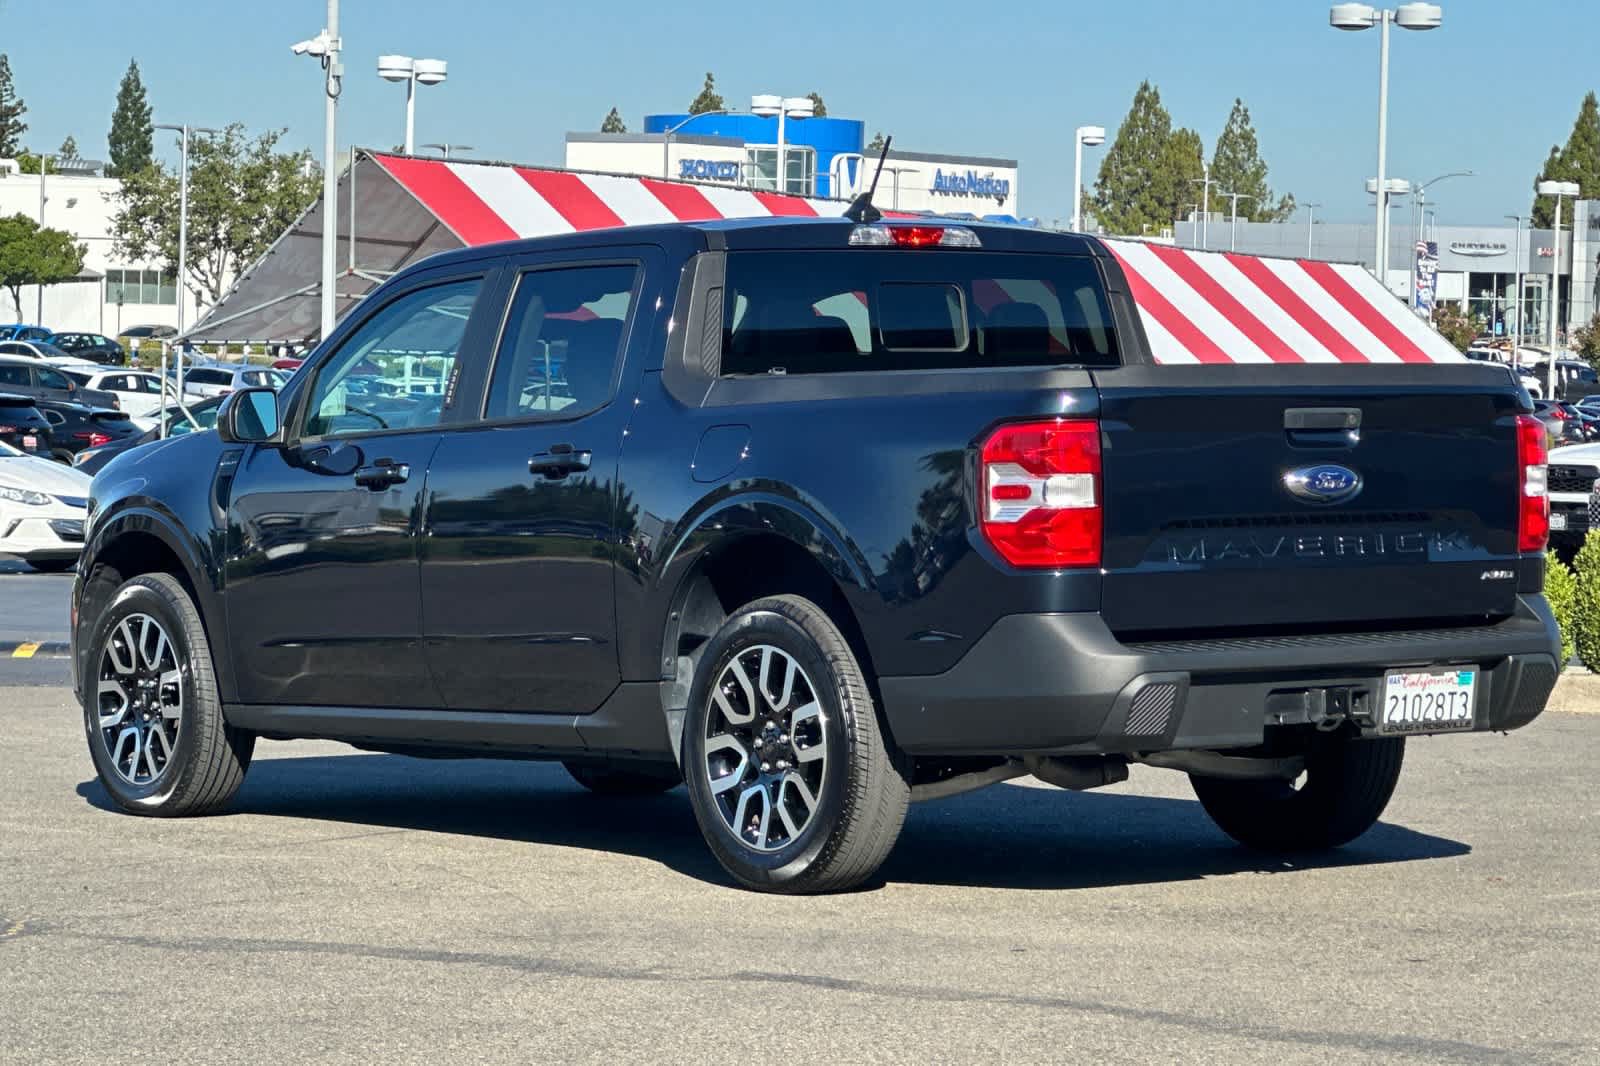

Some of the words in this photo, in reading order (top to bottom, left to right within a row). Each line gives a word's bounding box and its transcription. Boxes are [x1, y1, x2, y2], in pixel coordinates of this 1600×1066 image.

[932, 168, 1010, 198] AutoNation
[1315, 471, 1346, 489] Ford
[1168, 531, 1468, 562] MAVERICK
[1387, 691, 1469, 722] 21028T3
